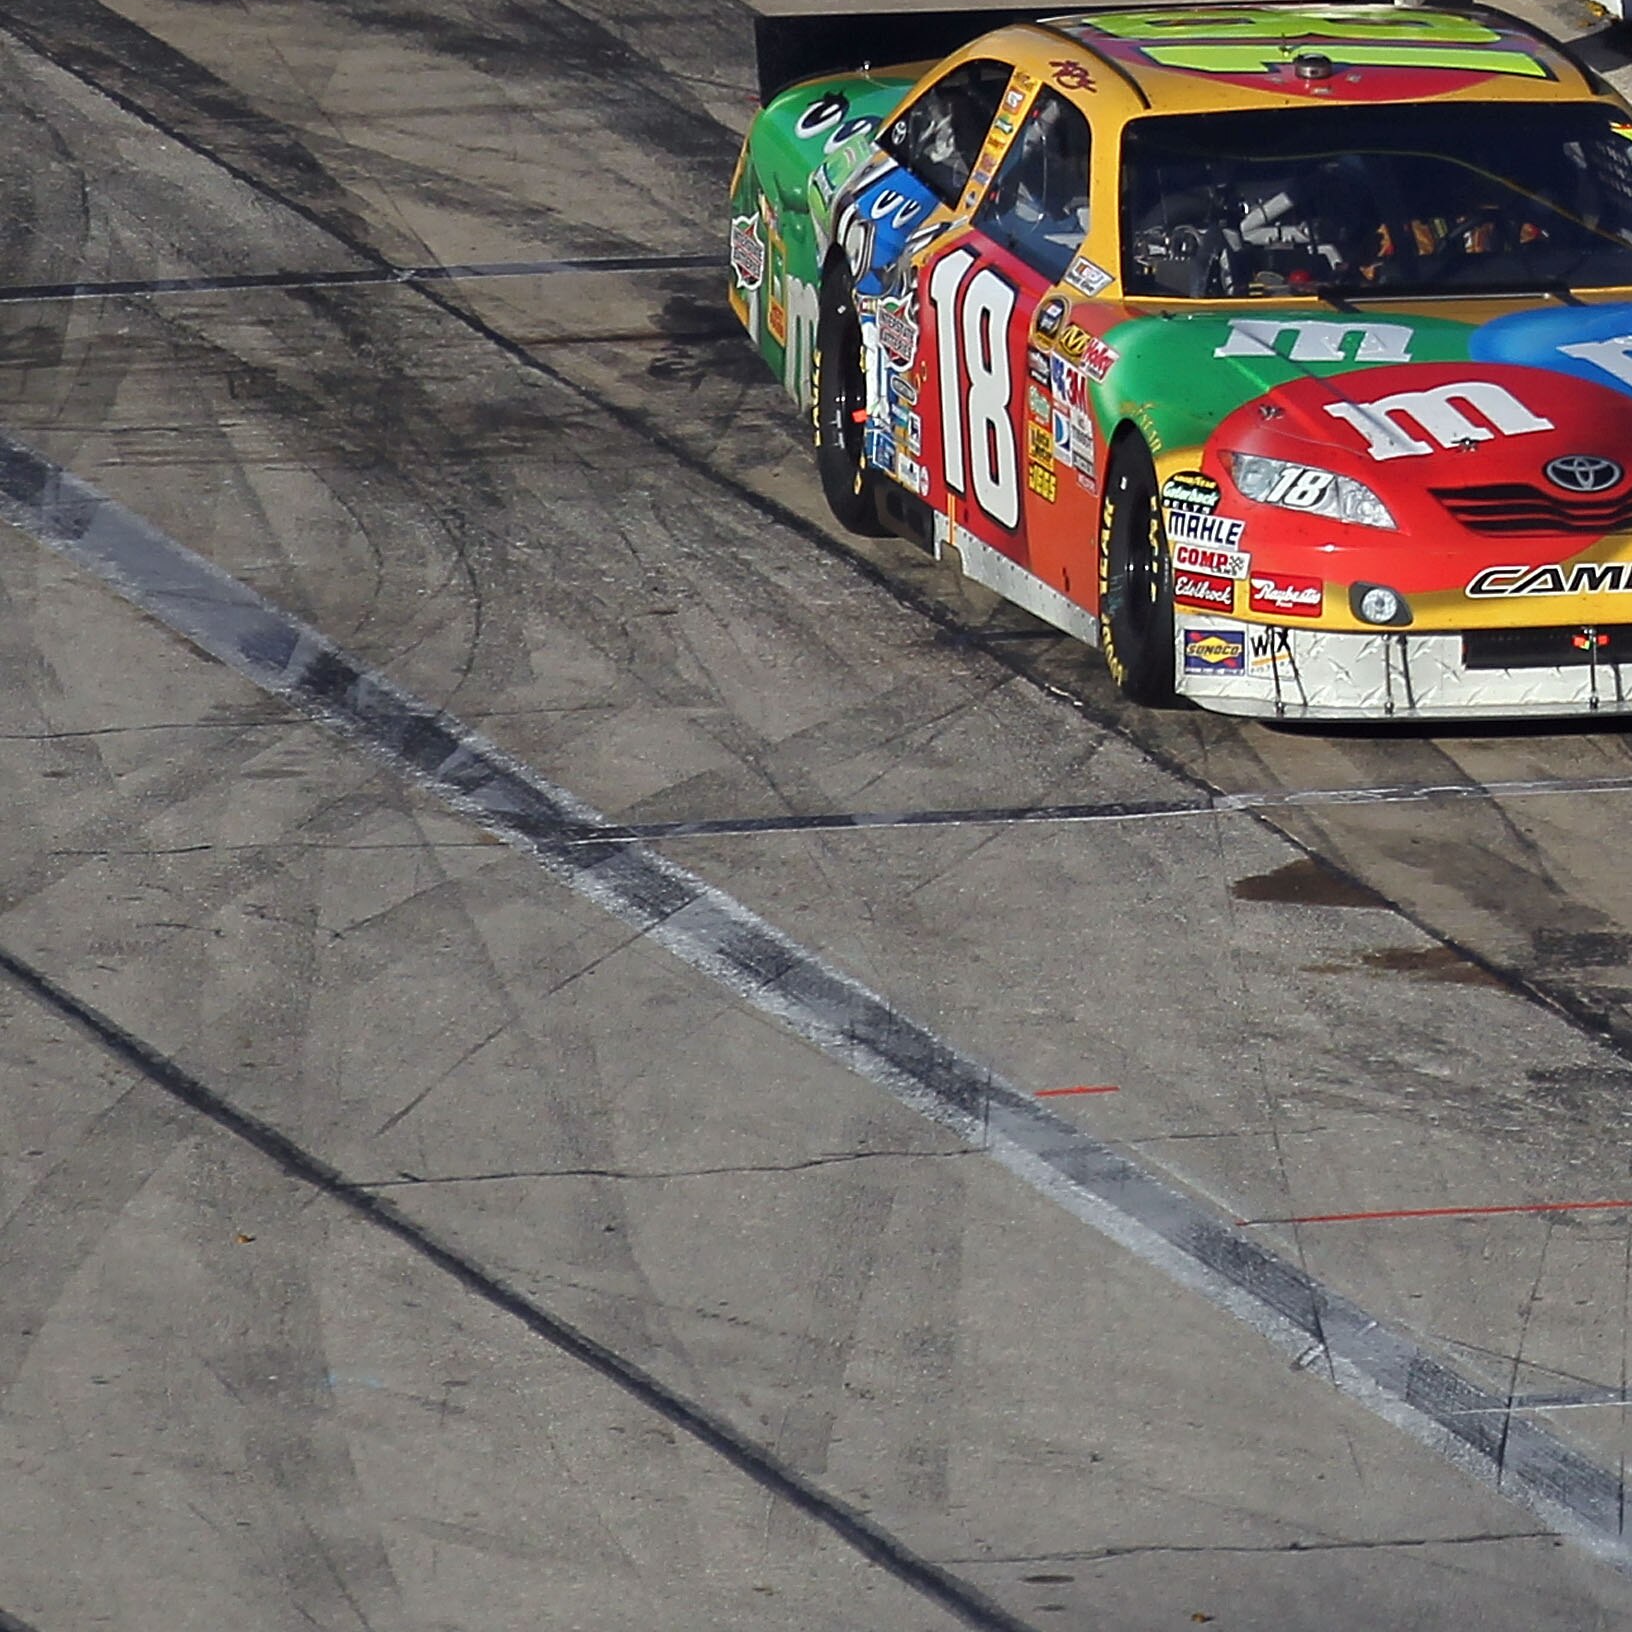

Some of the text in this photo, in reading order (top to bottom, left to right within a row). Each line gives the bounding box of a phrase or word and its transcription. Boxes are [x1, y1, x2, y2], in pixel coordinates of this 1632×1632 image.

[928, 246, 1022, 534] 18
[1325, 381, 1556, 462] m
[1266, 467, 1332, 507] 18
[1168, 511, 1243, 547] MAHLE
[1177, 546, 1228, 569] COMP
[1174, 576, 1232, 605] Edelbrock
[1252, 579, 1321, 604] Raybestos
[1187, 644, 1240, 657] SUNOCO
[1250, 630, 1291, 657] WIX
